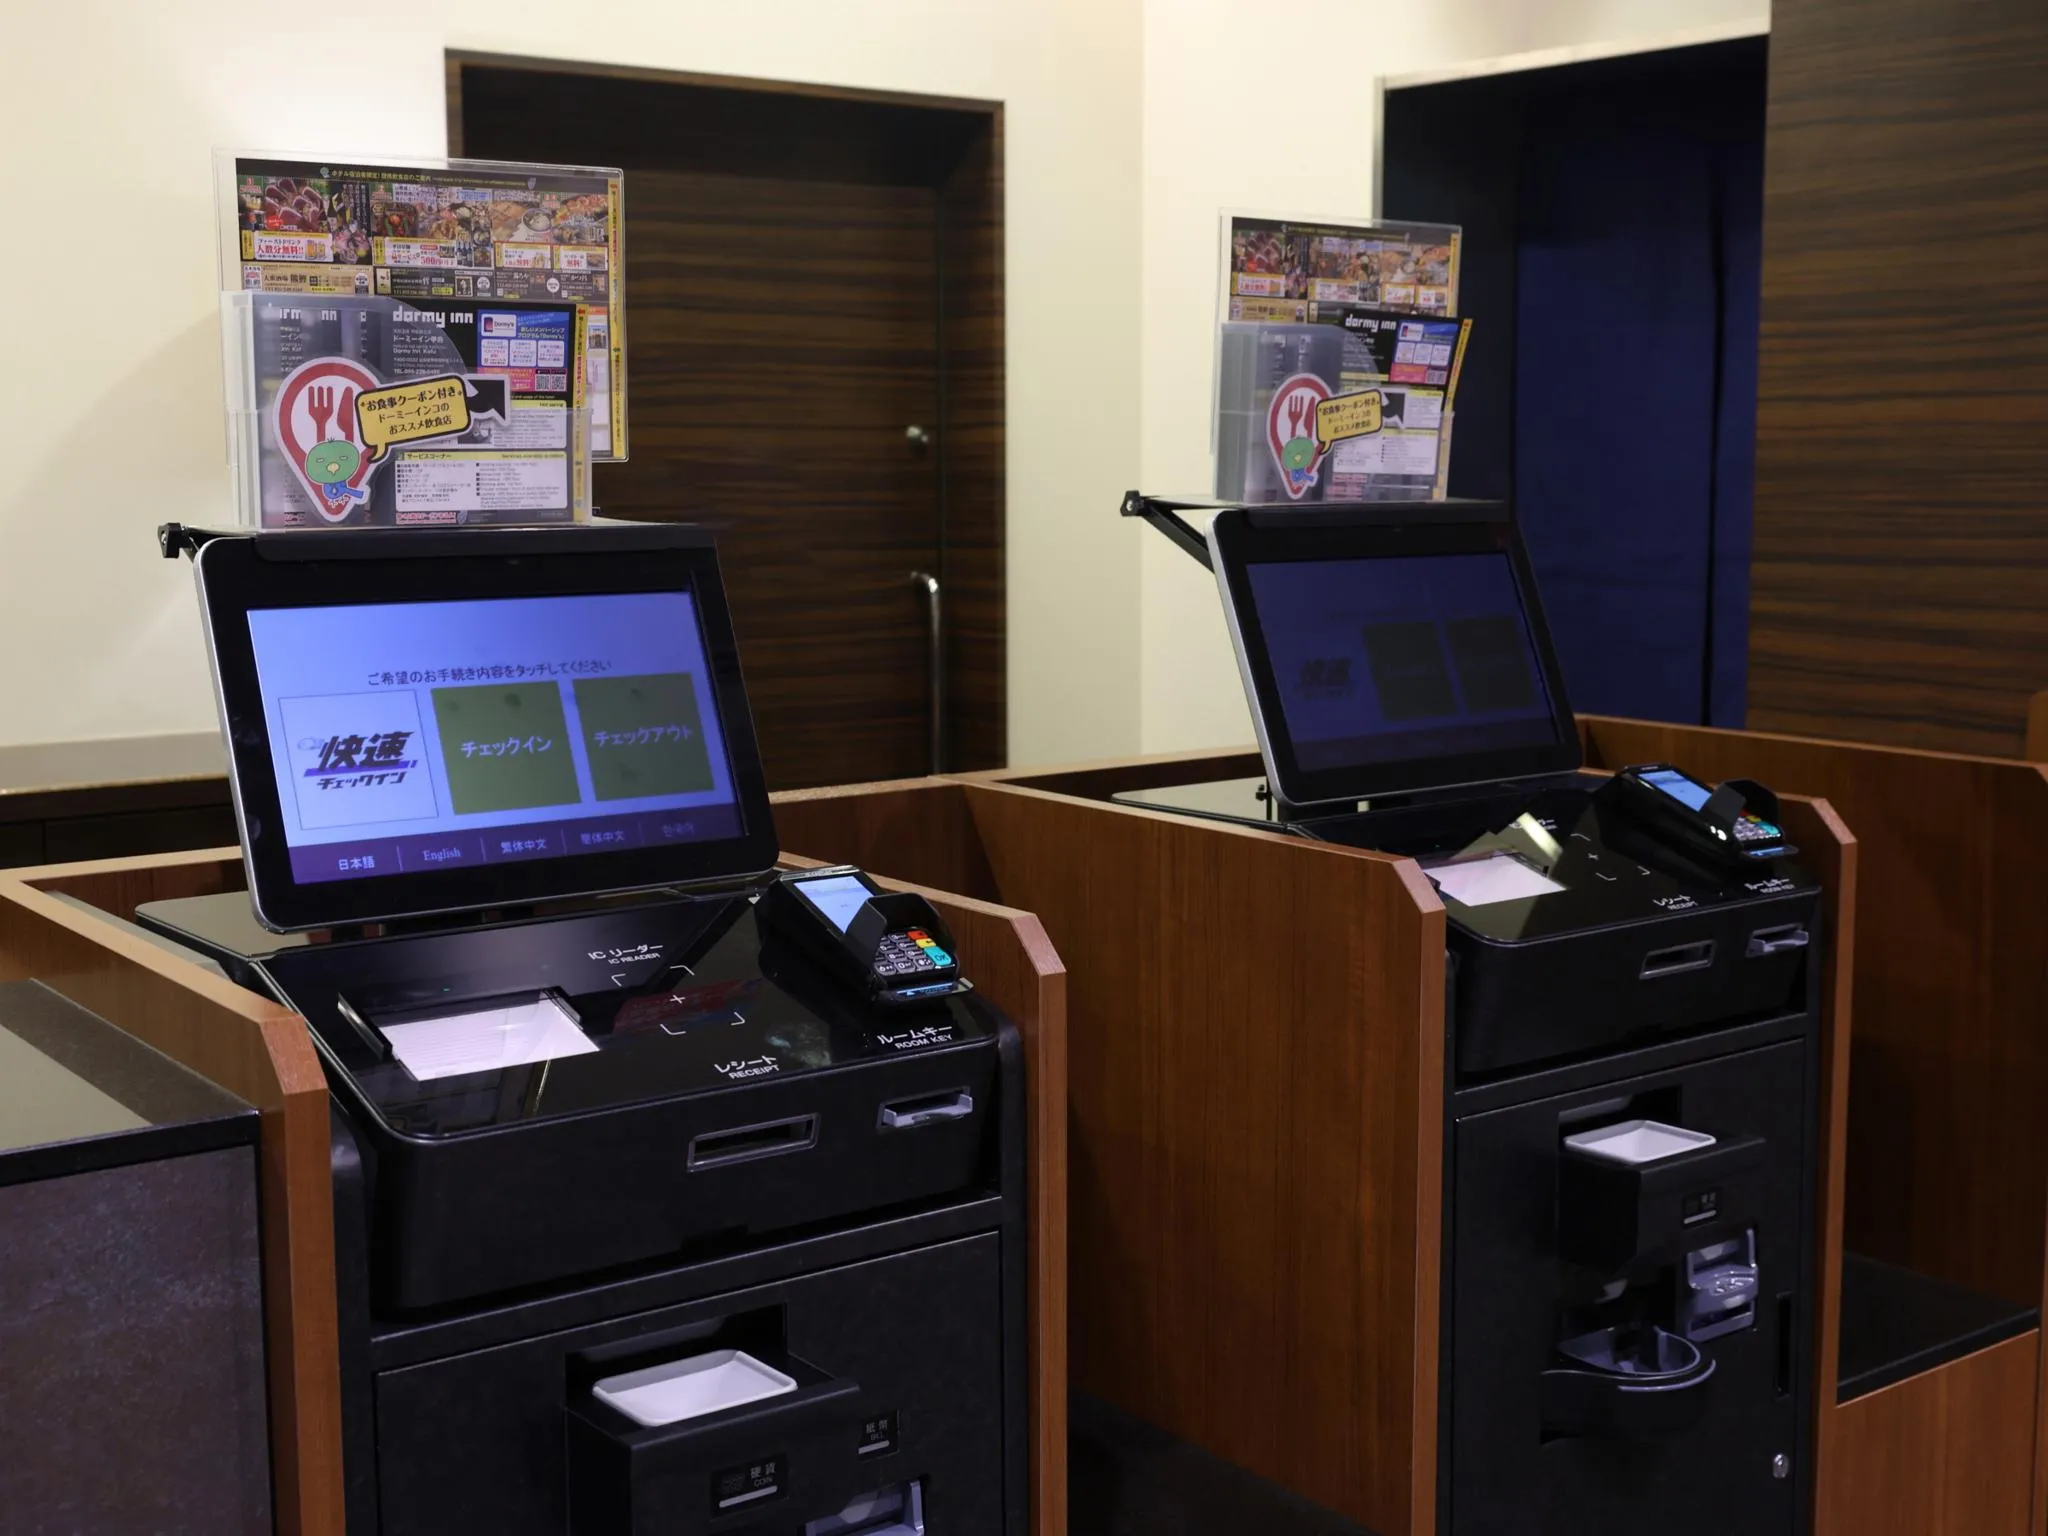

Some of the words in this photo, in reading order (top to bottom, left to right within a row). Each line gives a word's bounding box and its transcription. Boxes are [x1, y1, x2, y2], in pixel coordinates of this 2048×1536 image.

[393, 305, 446, 329] dormy
[450, 312, 474, 324] inn
[1345, 313, 1379, 333] dormy
[1381, 320, 1397, 331] inn
[367, 386, 456, 412] お食事クーポン付き
[378, 403, 450, 423] ドーミーインコの
[389, 415, 452, 435] おススメ飲食店
[367, 658, 613, 687] ご希望のお手続き内容をタッチしてください
[593, 723, 694, 749] チェックアウト
[318, 731, 413, 771] 快速
[459, 735, 552, 759] チェックイン
[317, 769, 408, 791] チェックイン
[338, 854, 375, 872] 日本語
[423, 845, 461, 863] English
[587, 950, 607, 961] IC
[609, 943, 664, 958] リーダー
[608, 957, 621, 965] IC
[620, 952, 661, 963] READER
[876, 1024, 953, 1045] ルームキー
[894, 1034, 931, 1050] ROOM
[930, 1031, 953, 1045] KEY
[714, 1053, 778, 1074] レシート
[729, 1062, 780, 1080] RECEIPT
